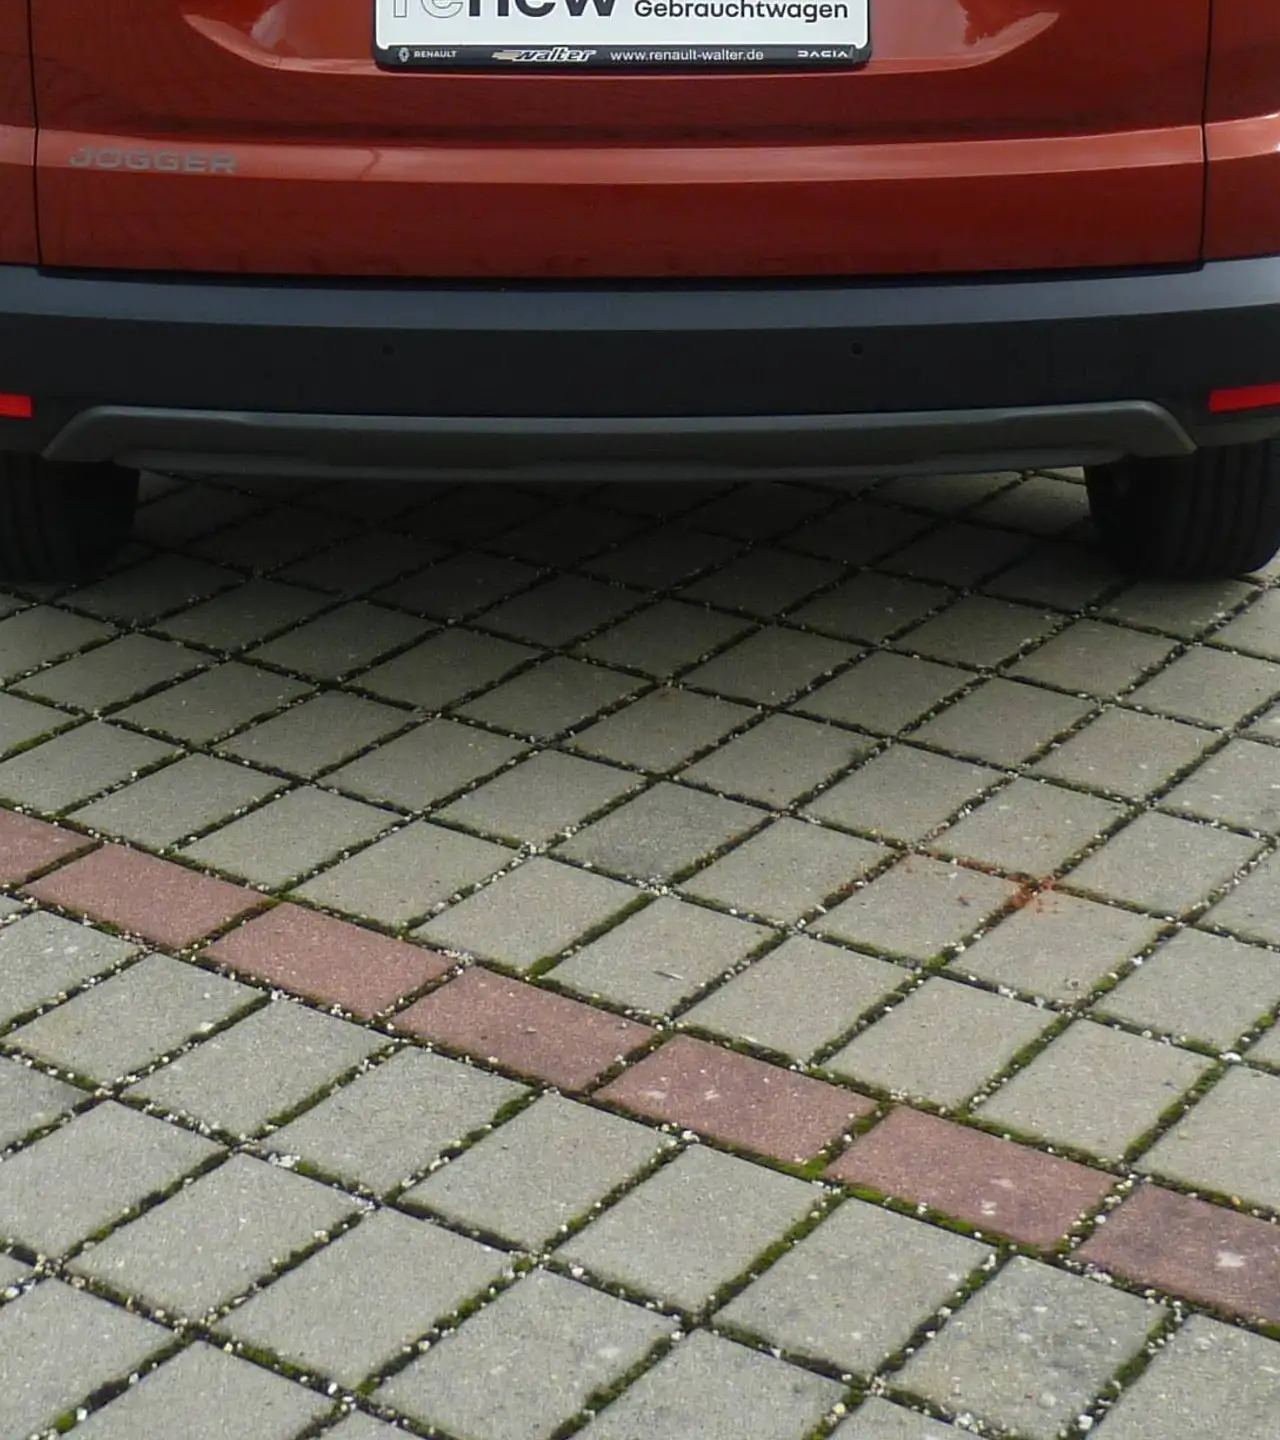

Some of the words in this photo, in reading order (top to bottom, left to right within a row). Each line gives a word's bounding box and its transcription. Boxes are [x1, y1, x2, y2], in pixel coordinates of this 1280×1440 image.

[413, 50, 457, 58] RENAULT
[513, 46, 597, 62] walter
[610, 48, 764, 61] www.renault-walter.de
[797, 50, 849, 58] DACIA
[70, 145, 238, 174] JOGGER
